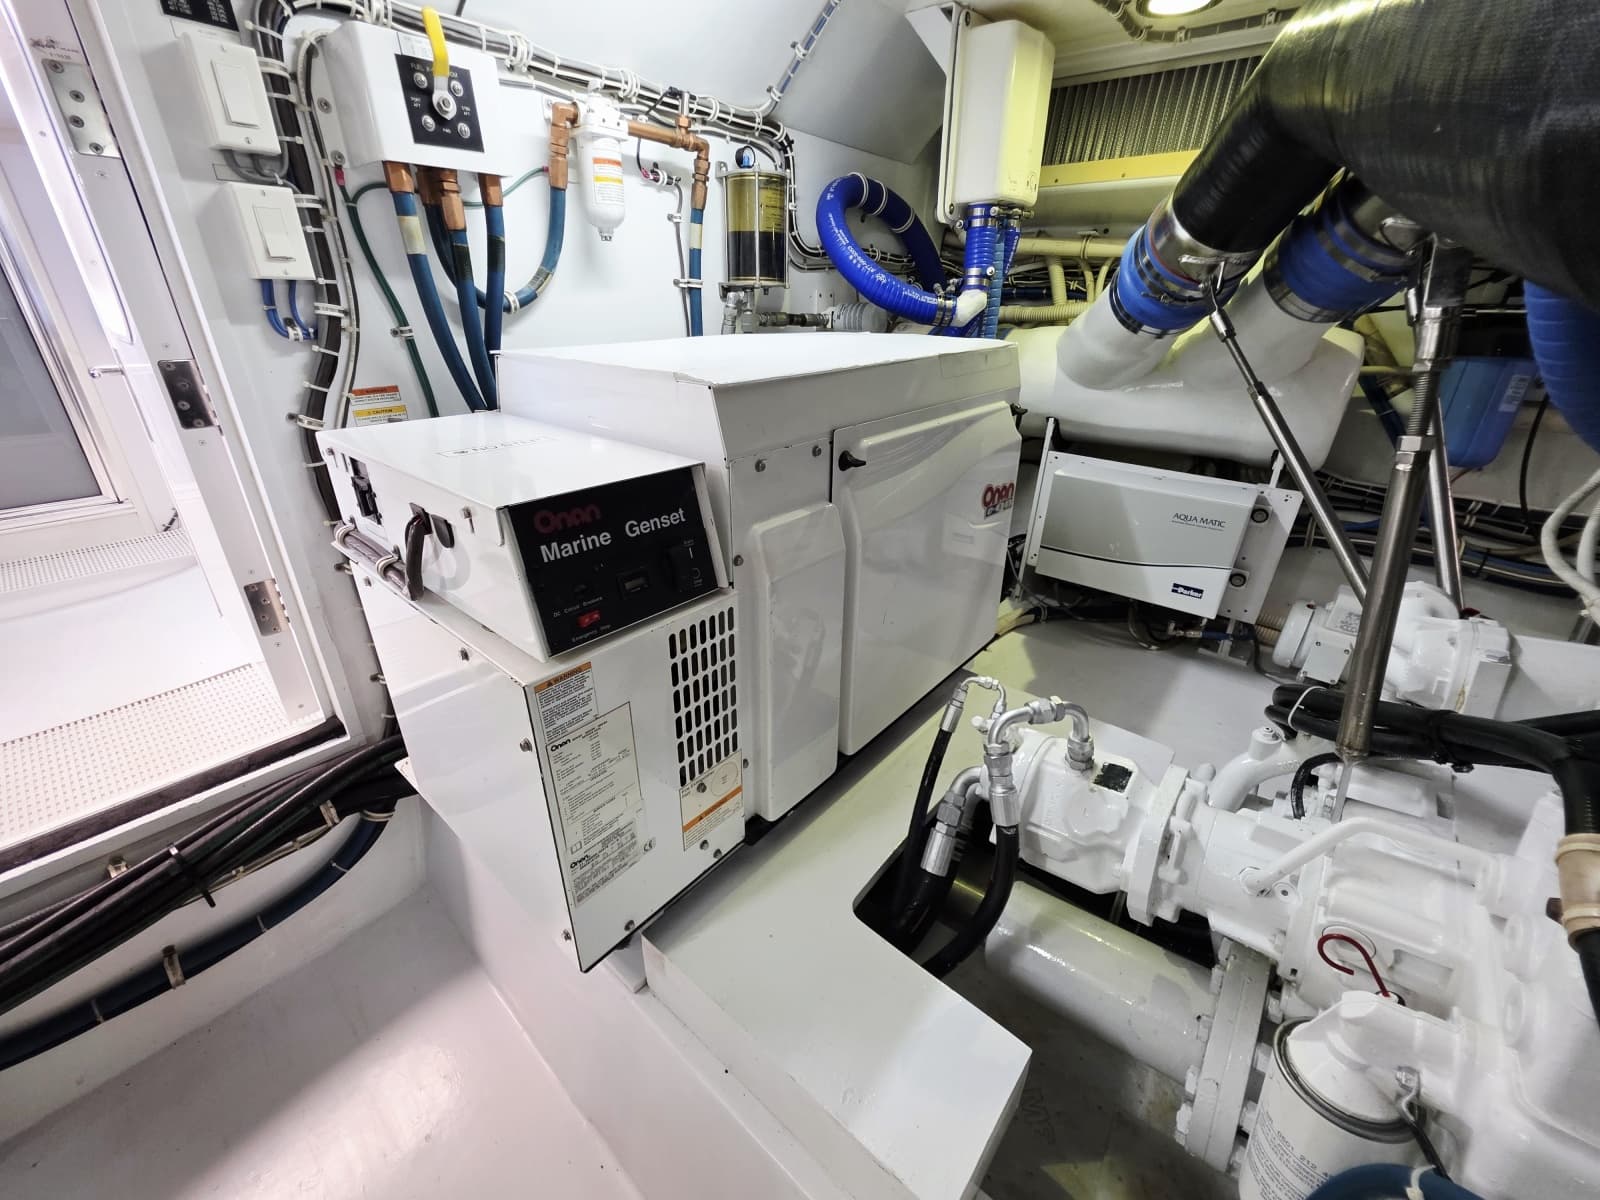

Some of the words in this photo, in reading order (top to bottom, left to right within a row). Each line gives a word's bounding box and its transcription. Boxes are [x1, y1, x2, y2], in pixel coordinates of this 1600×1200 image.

[981, 482, 1015, 508] Onan
[534, 503, 602, 534] Onan
[1172, 512, 1198, 523] AQUA
[1199, 517, 1226, 529] MATIC
[540, 531, 613, 563] Marine
[625, 507, 687, 538] Genset
[551, 738, 571, 752] Onan
[570, 854, 589, 869] Onan
